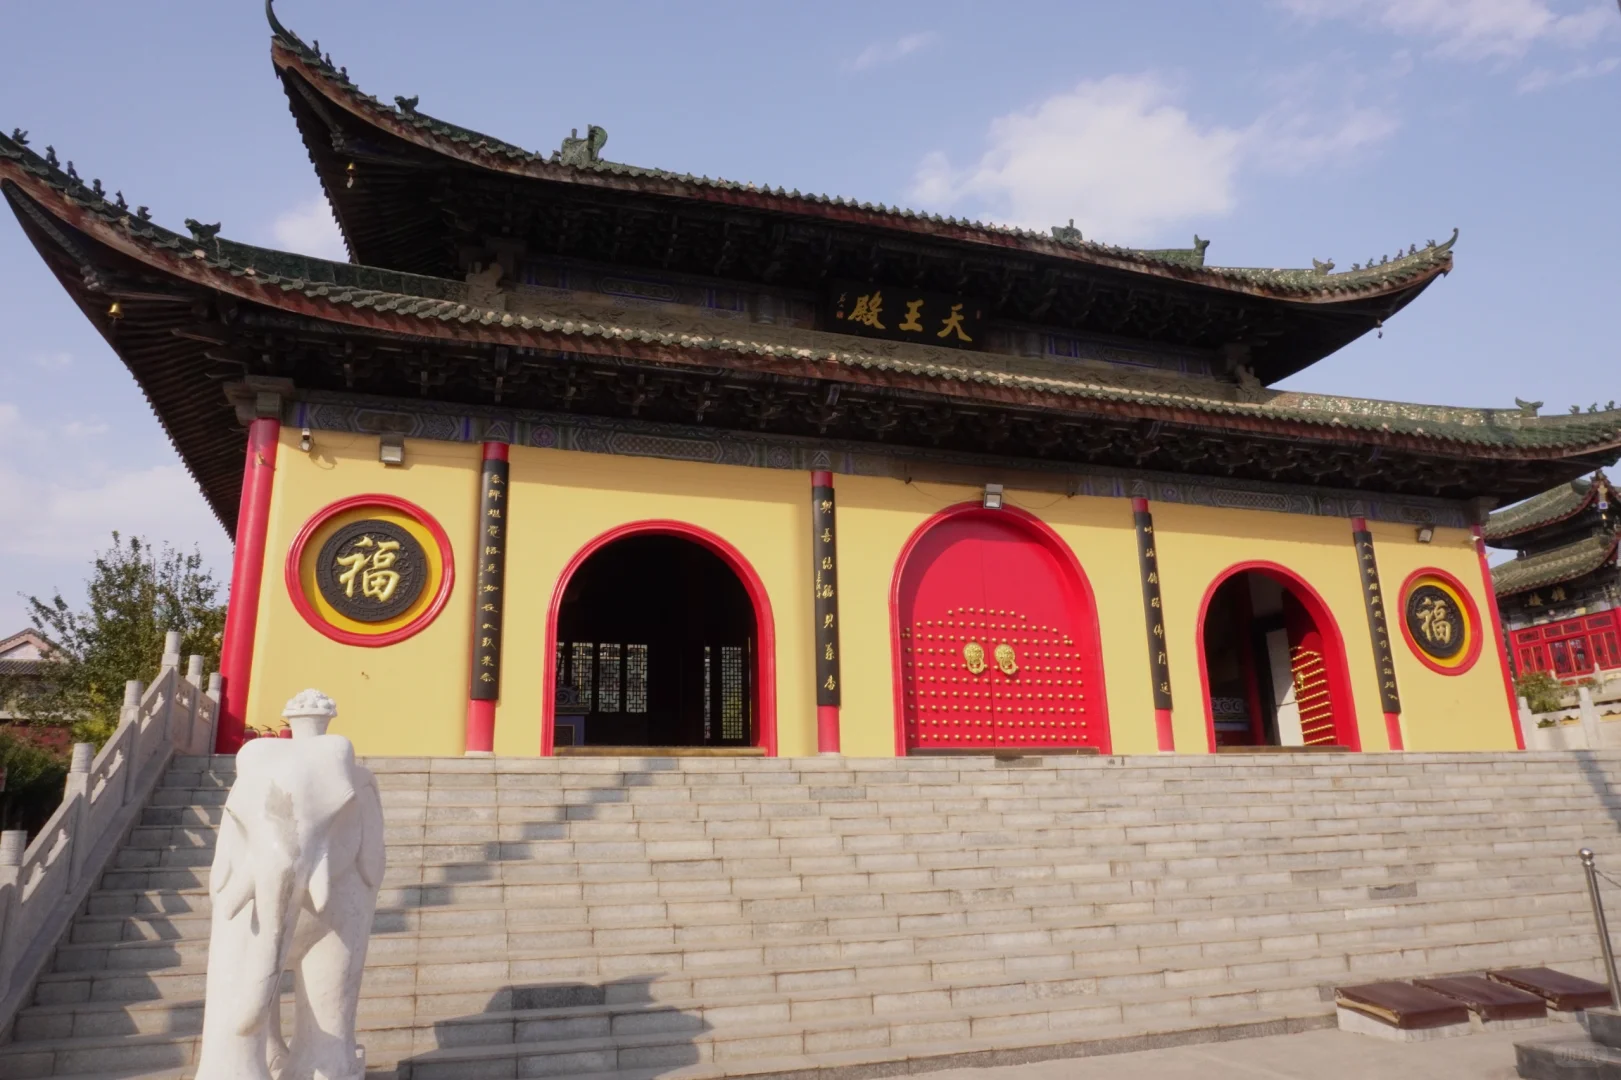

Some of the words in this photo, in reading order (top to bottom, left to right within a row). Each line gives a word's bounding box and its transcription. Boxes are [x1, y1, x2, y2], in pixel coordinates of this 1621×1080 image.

[847, 290, 973, 343] 天王殿
[337, 535, 402, 603] 福
[1416, 595, 1454, 645] 福
